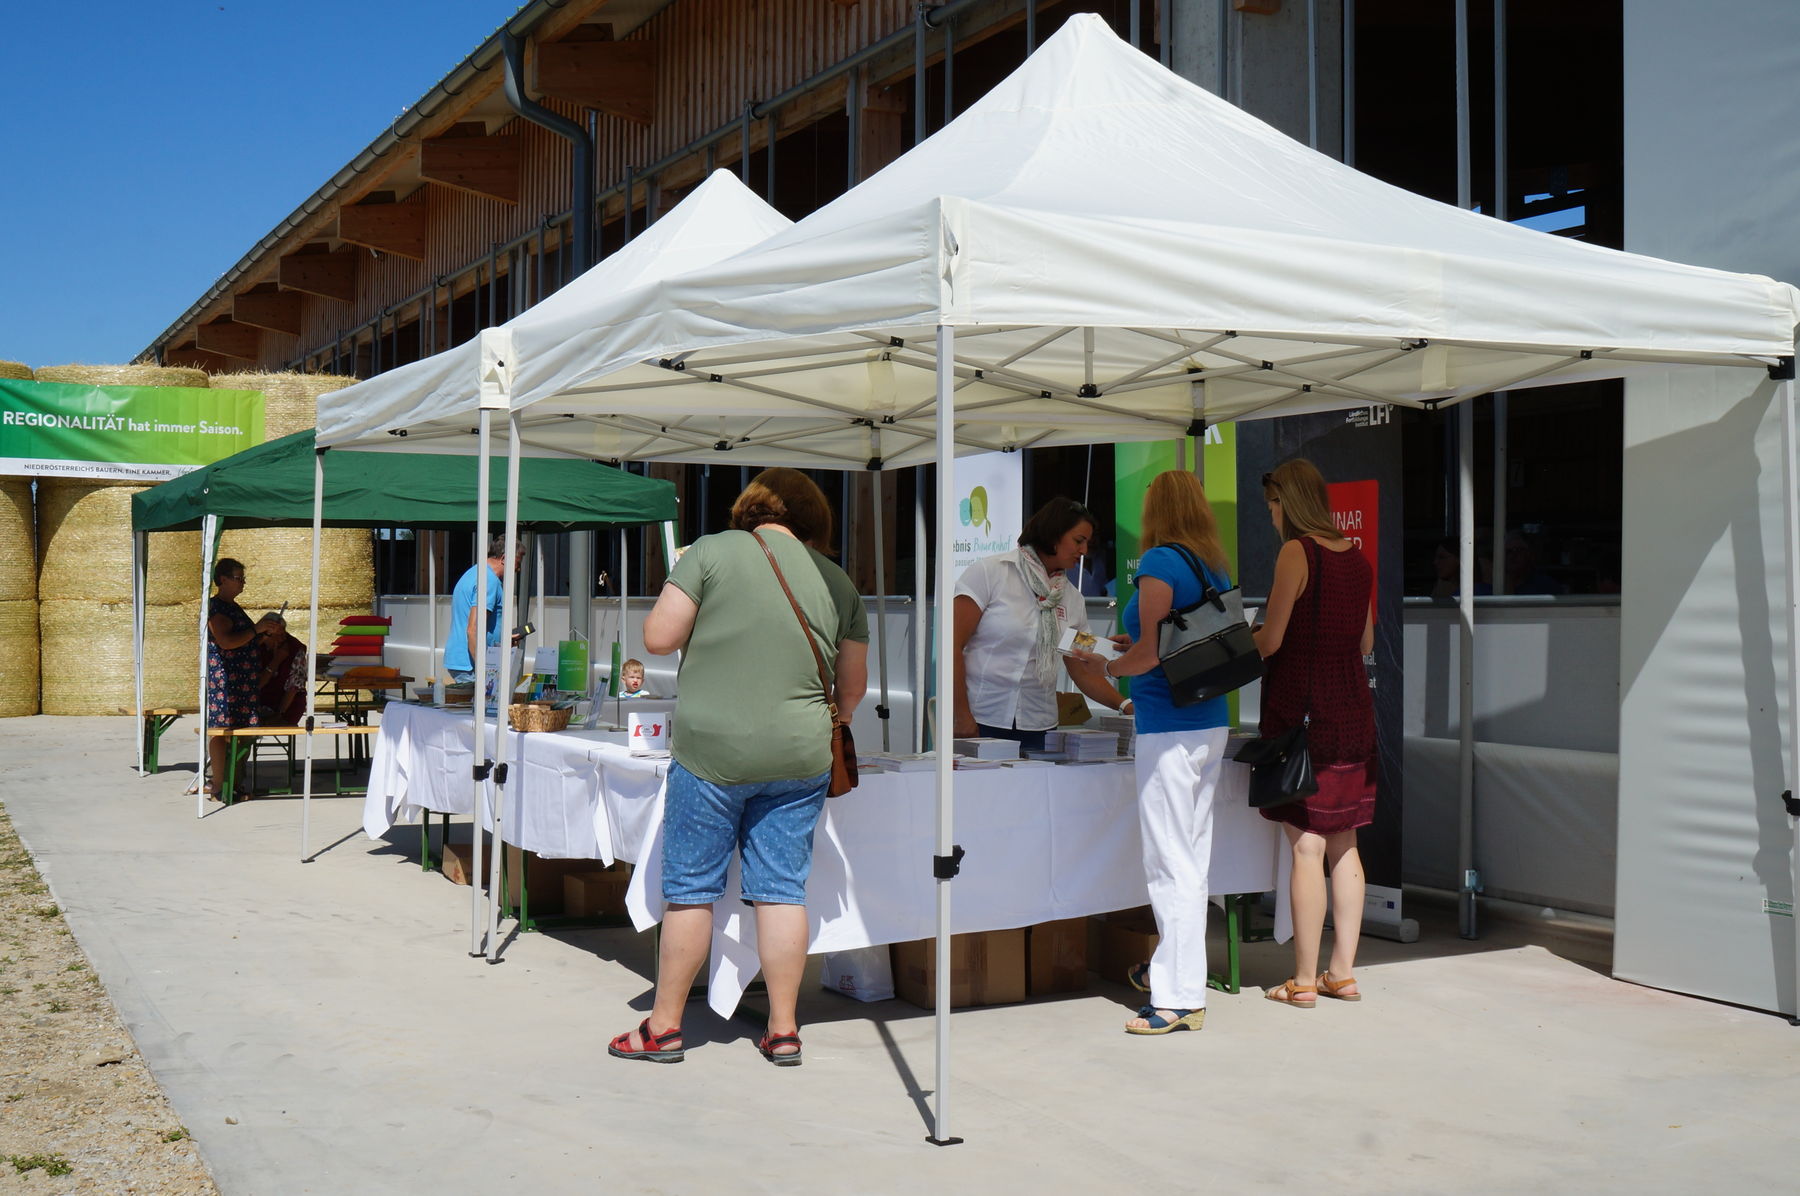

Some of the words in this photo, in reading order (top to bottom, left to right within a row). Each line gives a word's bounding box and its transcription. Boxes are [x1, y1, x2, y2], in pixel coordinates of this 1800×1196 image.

[3, 411, 125, 430] REGIONALITÄT
[128, 418, 150, 431] hat
[154, 419, 196, 433] immer
[199, 420, 243, 435] Saison.
[1331, 510, 1362, 530] INAR
